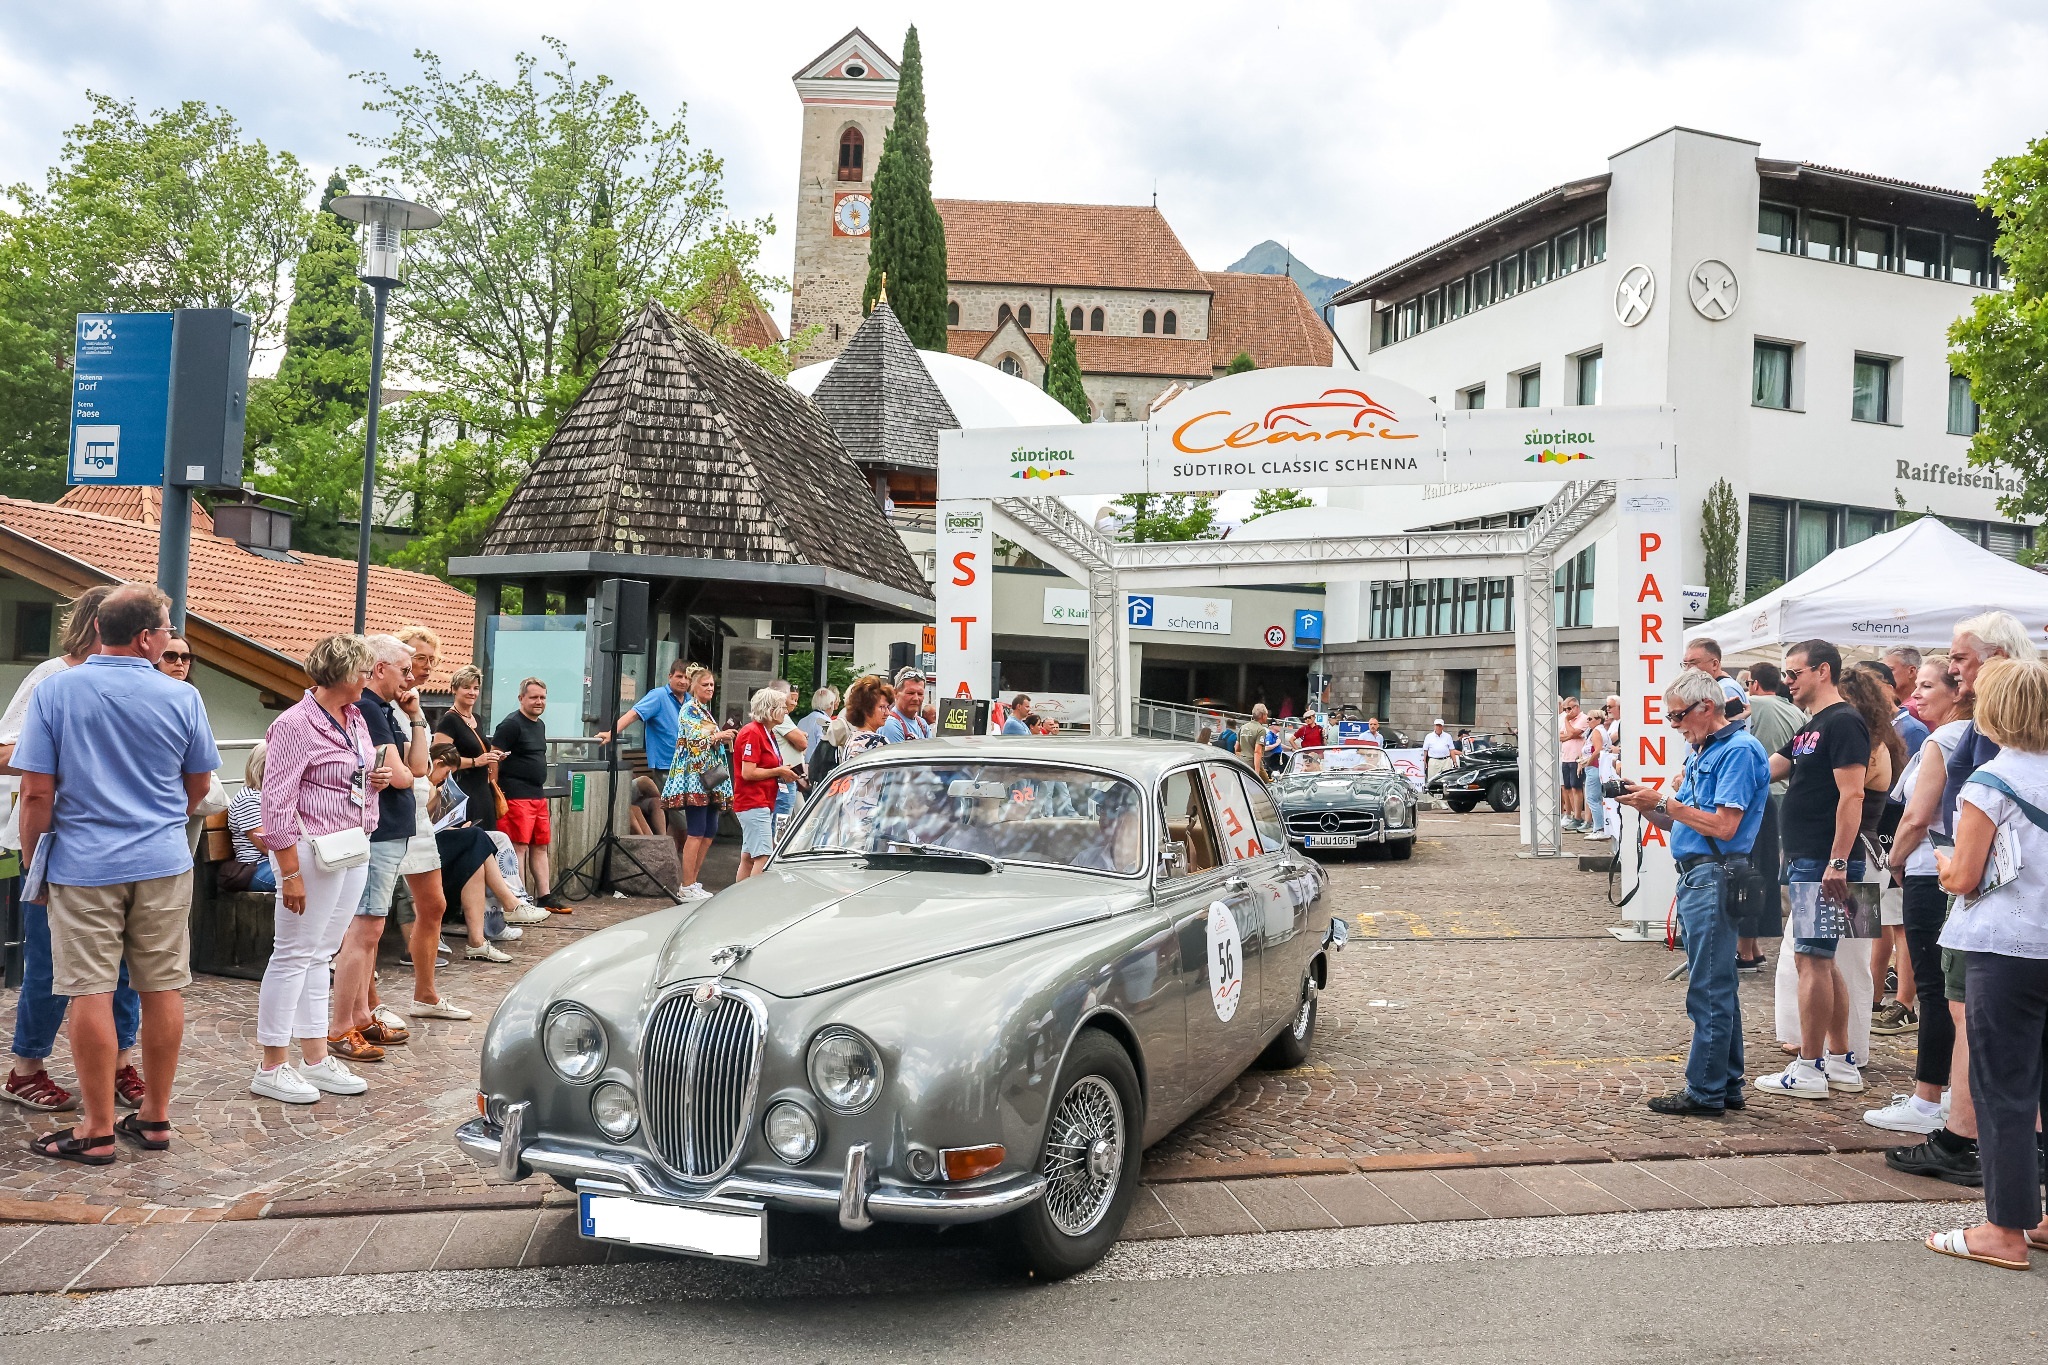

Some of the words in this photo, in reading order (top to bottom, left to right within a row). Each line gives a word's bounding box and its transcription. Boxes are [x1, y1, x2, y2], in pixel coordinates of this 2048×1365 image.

[78, 382, 98, 391] Dorf
[76, 409, 100, 418] Paese
[1172, 410, 1419, 453] Classic
[1173, 462, 1256, 477] SÜDTIROL
[1261, 460, 1329, 474] CLASSIC
[1335, 457, 1418, 472] SCHENNA
[948, 517, 981, 528] FORST
[1132, 605, 1148, 624] P
[1167, 616, 1219, 631] schenna
[1304, 618, 1314, 630] P
[1851, 619, 1910, 634] schenna
[945, 708, 969, 724] ALGE
[827, 774, 854, 797] 56
[1217, 938, 1235, 985] 56
[586, 1218, 593, 1228] D
